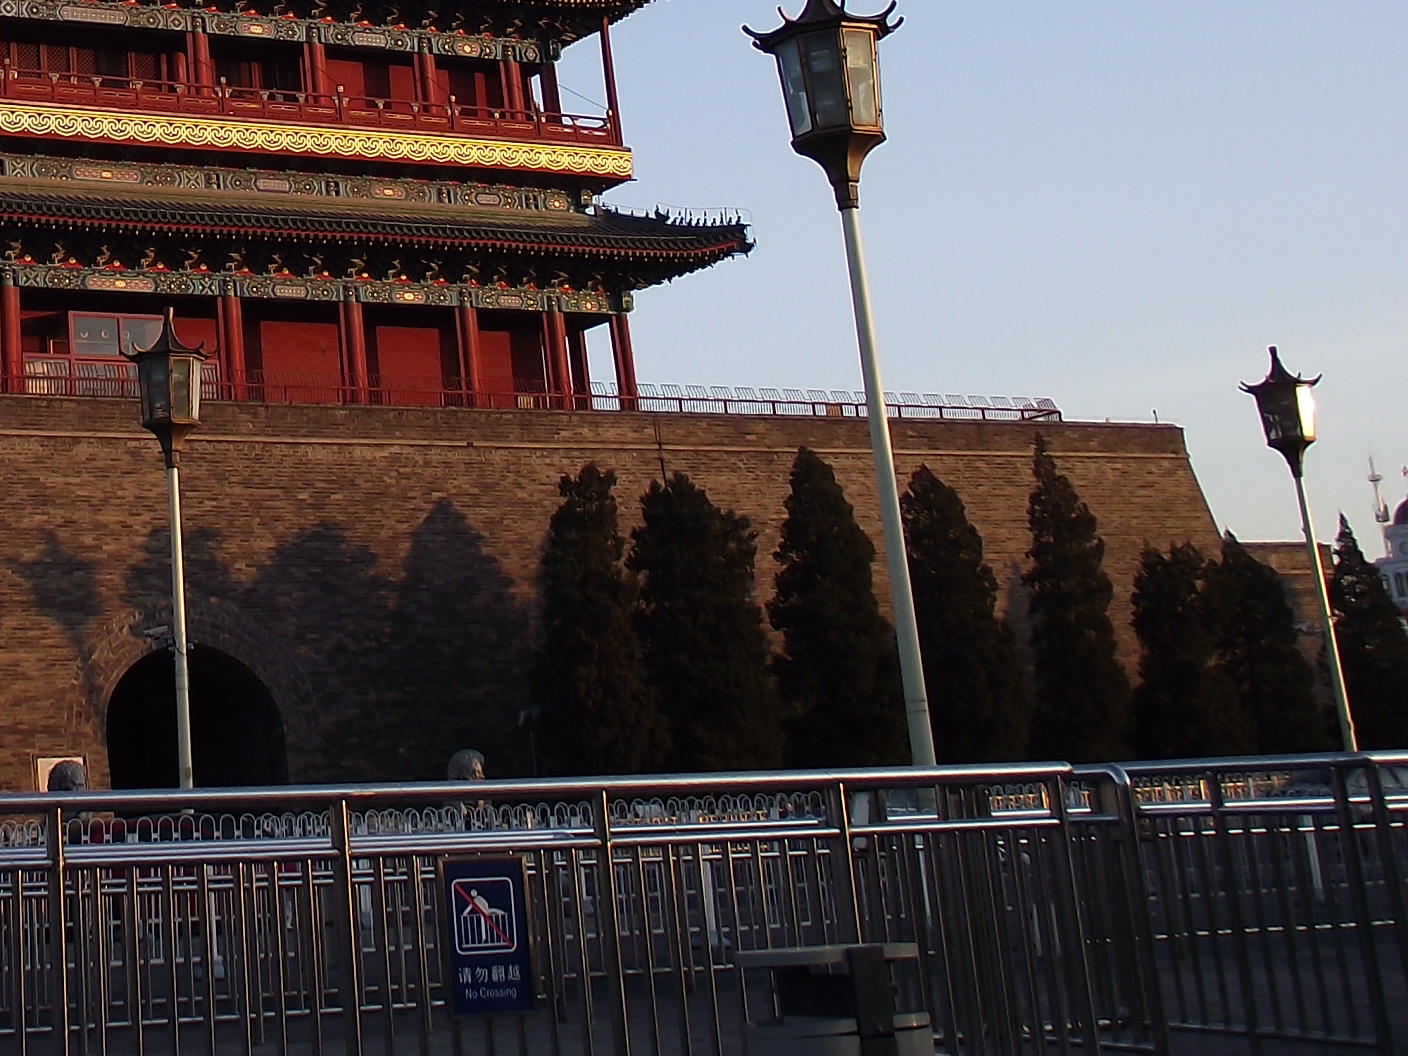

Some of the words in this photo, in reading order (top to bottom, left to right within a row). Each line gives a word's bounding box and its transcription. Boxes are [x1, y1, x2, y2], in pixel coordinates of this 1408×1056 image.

[458, 964, 521, 984] 请勿翻越
[465, 987, 478, 1000] No
[479, 986, 517, 1000] Crossing
